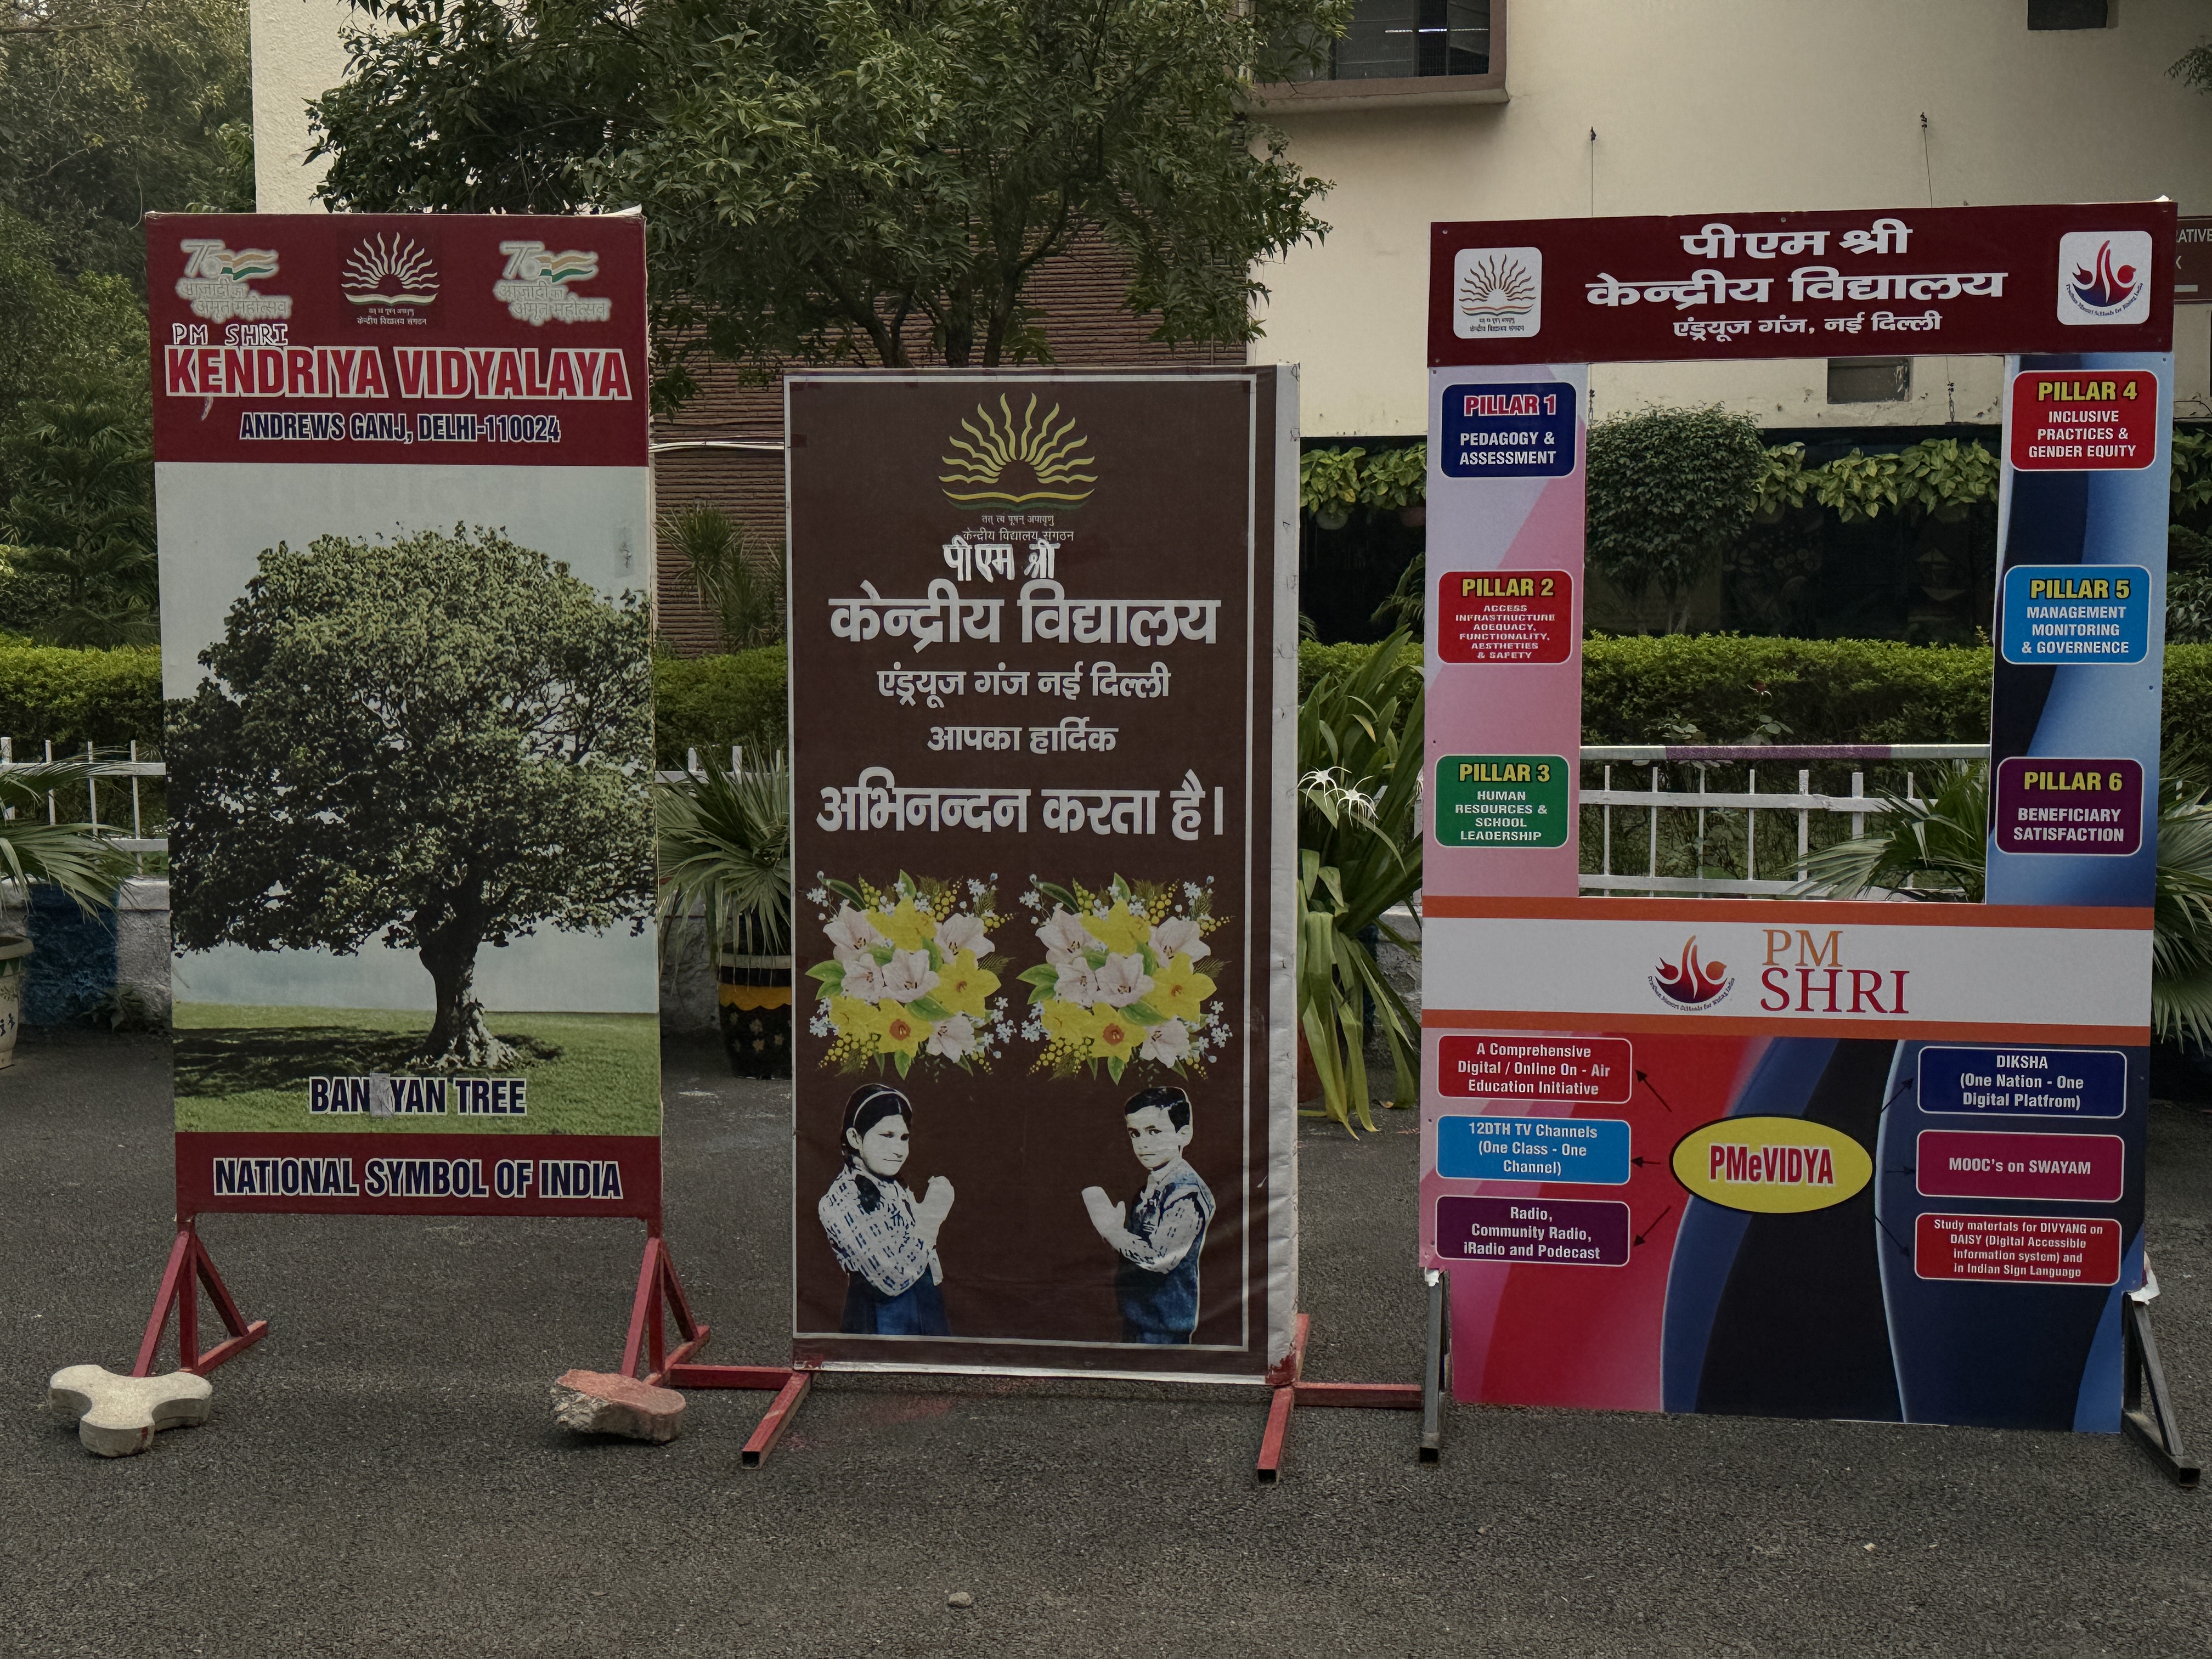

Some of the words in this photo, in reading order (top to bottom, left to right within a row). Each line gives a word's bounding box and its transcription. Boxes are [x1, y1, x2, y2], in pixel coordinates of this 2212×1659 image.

[1839, 218, 1913, 254] श्री
[1585, 269, 1774, 311] केन्द्रीय
[1788, 266, 2008, 302] विद्यालय
[1758, 314, 1815, 335] गंज,
[1825, 312, 1865, 334] नई
[1871, 309, 1943, 332] दिल्ली
[172, 323, 208, 345] PM
[224, 323, 288, 346] SHRI
[165, 345, 389, 398] KENDRIYA
[393, 347, 633, 400] VIDYALAYA
[2038, 381, 2117, 401] PILLAR
[2123, 381, 2138, 400] 4
[1464, 394, 1539, 417] PILLAR
[1543, 394, 1556, 415] 1
[2049, 410, 2119, 423] INCLUSIVE
[239, 412, 346, 441] ANDREWS
[349, 413, 413, 444] GANJ,
[417, 413, 561, 442] DELHI-110024
[2038, 427, 2114, 441] PRACTICES
[2118, 427, 2129, 440] &
[1460, 431, 1539, 446] PEDAGOGY
[1543, 431, 1555, 445] &
[1459, 450, 1556, 465] ASSESSMENT
[2029, 445, 2082, 458] GENDER
[2087, 444, 2136, 459] EQUITY
[962, 527, 995, 541] केन्द्रीय
[999, 527, 1039, 541] विद्यालय
[1042, 528, 1074, 541] संगठन
[1462, 578, 1534, 597] PILLAR
[1540, 578, 1554, 597] 2
[2030, 579, 2109, 599] PILLAR
[2115, 579, 2131, 599] 5
[828, 578, 1006, 653] केन्द्रीय
[1017, 578, 1221, 647] विद्यालय
[2027, 606, 2126, 619] MANAGEMENT
[1473, 623, 1537, 632] ADEQUACY,
[2032, 623, 2120, 636] MONITORING
[2022, 641, 2032, 654] &
[2037, 641, 2129, 654] GOVERNENCE
[974, 662, 1030, 697] गंज
[1037, 662, 1084, 701] नई
[1090, 661, 1172, 698] दिल्ली
[927, 726, 1022, 752] आपका
[1029, 716, 1119, 754] हार्दिक
[1459, 763, 1531, 782] PILLAR
[1537, 764, 1551, 782] 3
[2024, 771, 2102, 791] PILLAR
[2108, 772, 2123, 792] 6
[816, 767, 1031, 833] अभिनन्दन
[1041, 788, 1160, 835] करता
[1477, 791, 1526, 801] HUMAN
[1455, 804, 1533, 814] RESOURCES
[1537, 804, 1548, 815] &
[2018, 808, 2121, 822] BENEFICIARY
[1475, 817, 1527, 828] SCHOOL
[1460, 830, 1542, 841] LEADERSHIP
[2013, 826, 2124, 842] SATISFACTION
[1762, 929, 1843, 967] PM
[1760, 967, 1910, 1014] SHRI
[1476, 1042, 1486, 1055] A
[1489, 1042, 1592, 1059] Comprehensive
[1458, 1060, 1502, 1075] Digital
[1504, 1062, 1511, 1075] /
[1514, 1062, 1556, 1076] Online
[1560, 1063, 1577, 1076] On
[1591, 1064, 1611, 1077] Air
[1996, 1055, 2049, 1069] DIKSHA
[1468, 1079, 1534, 1093] Education
[1538, 1081, 1599, 1096] Initiative
[1960, 1073, 1992, 1090] (One
[1996, 1074, 2042, 1088] Nation
[2056, 1075, 2084, 1090] One
[453, 1077, 527, 1116] TREE
[1962, 1092, 2010, 1108] Digital
[2014, 1093, 2081, 1111] Platfrom)
[1468, 1122, 1511, 1136] 12DTH
[1515, 1123, 1532, 1137] TV
[1536, 1124, 1598, 1139] Channels
[1479, 1140, 1508, 1156] (One
[1512, 1142, 1549, 1156] Class
[1562, 1143, 1587, 1156] One
[1503, 1160, 1562, 1177] Channel)
[1709, 1143, 1835, 1186] PMeVIDYA
[1949, 1157, 2004, 1172] MOOC's
[2008, 1161, 2024, 1173] on
[2028, 1159, 2091, 1175] SWAYAM
[213, 1156, 359, 1196] NATIONAL
[365, 1158, 489, 1198] SYMBOL
[494, 1159, 533, 1198] OF
[539, 1160, 623, 1200] INDIA
[1510, 1206, 1553, 1222] Radio,
[1471, 1223, 1545, 1241] Community
[1549, 1226, 1592, 1243] Radio,
[1934, 1219, 1964, 1232] Study
[1967, 1221, 2019, 1232] materials
[2022, 1221, 2038, 1233] for
[2040, 1222, 2087, 1234] DIVYANG
[2090, 1226, 2103, 1235] on
[1950, 1234, 1982, 1245] DAISY
[1985, 1235, 2024, 1248] (Digital
[2028, 1236, 2086, 1249] Accessible
[1510, 1244, 1533, 1257] and
[1538, 1245, 1601, 1260] Podecast
[2018, 1251, 2059, 1264] system)
[2063, 1252, 2083, 1263] and
[1967, 1263, 2000, 1274] Indian
[2004, 1264, 2027, 1276] Sign
[2030, 1265, 2081, 1278] Language
